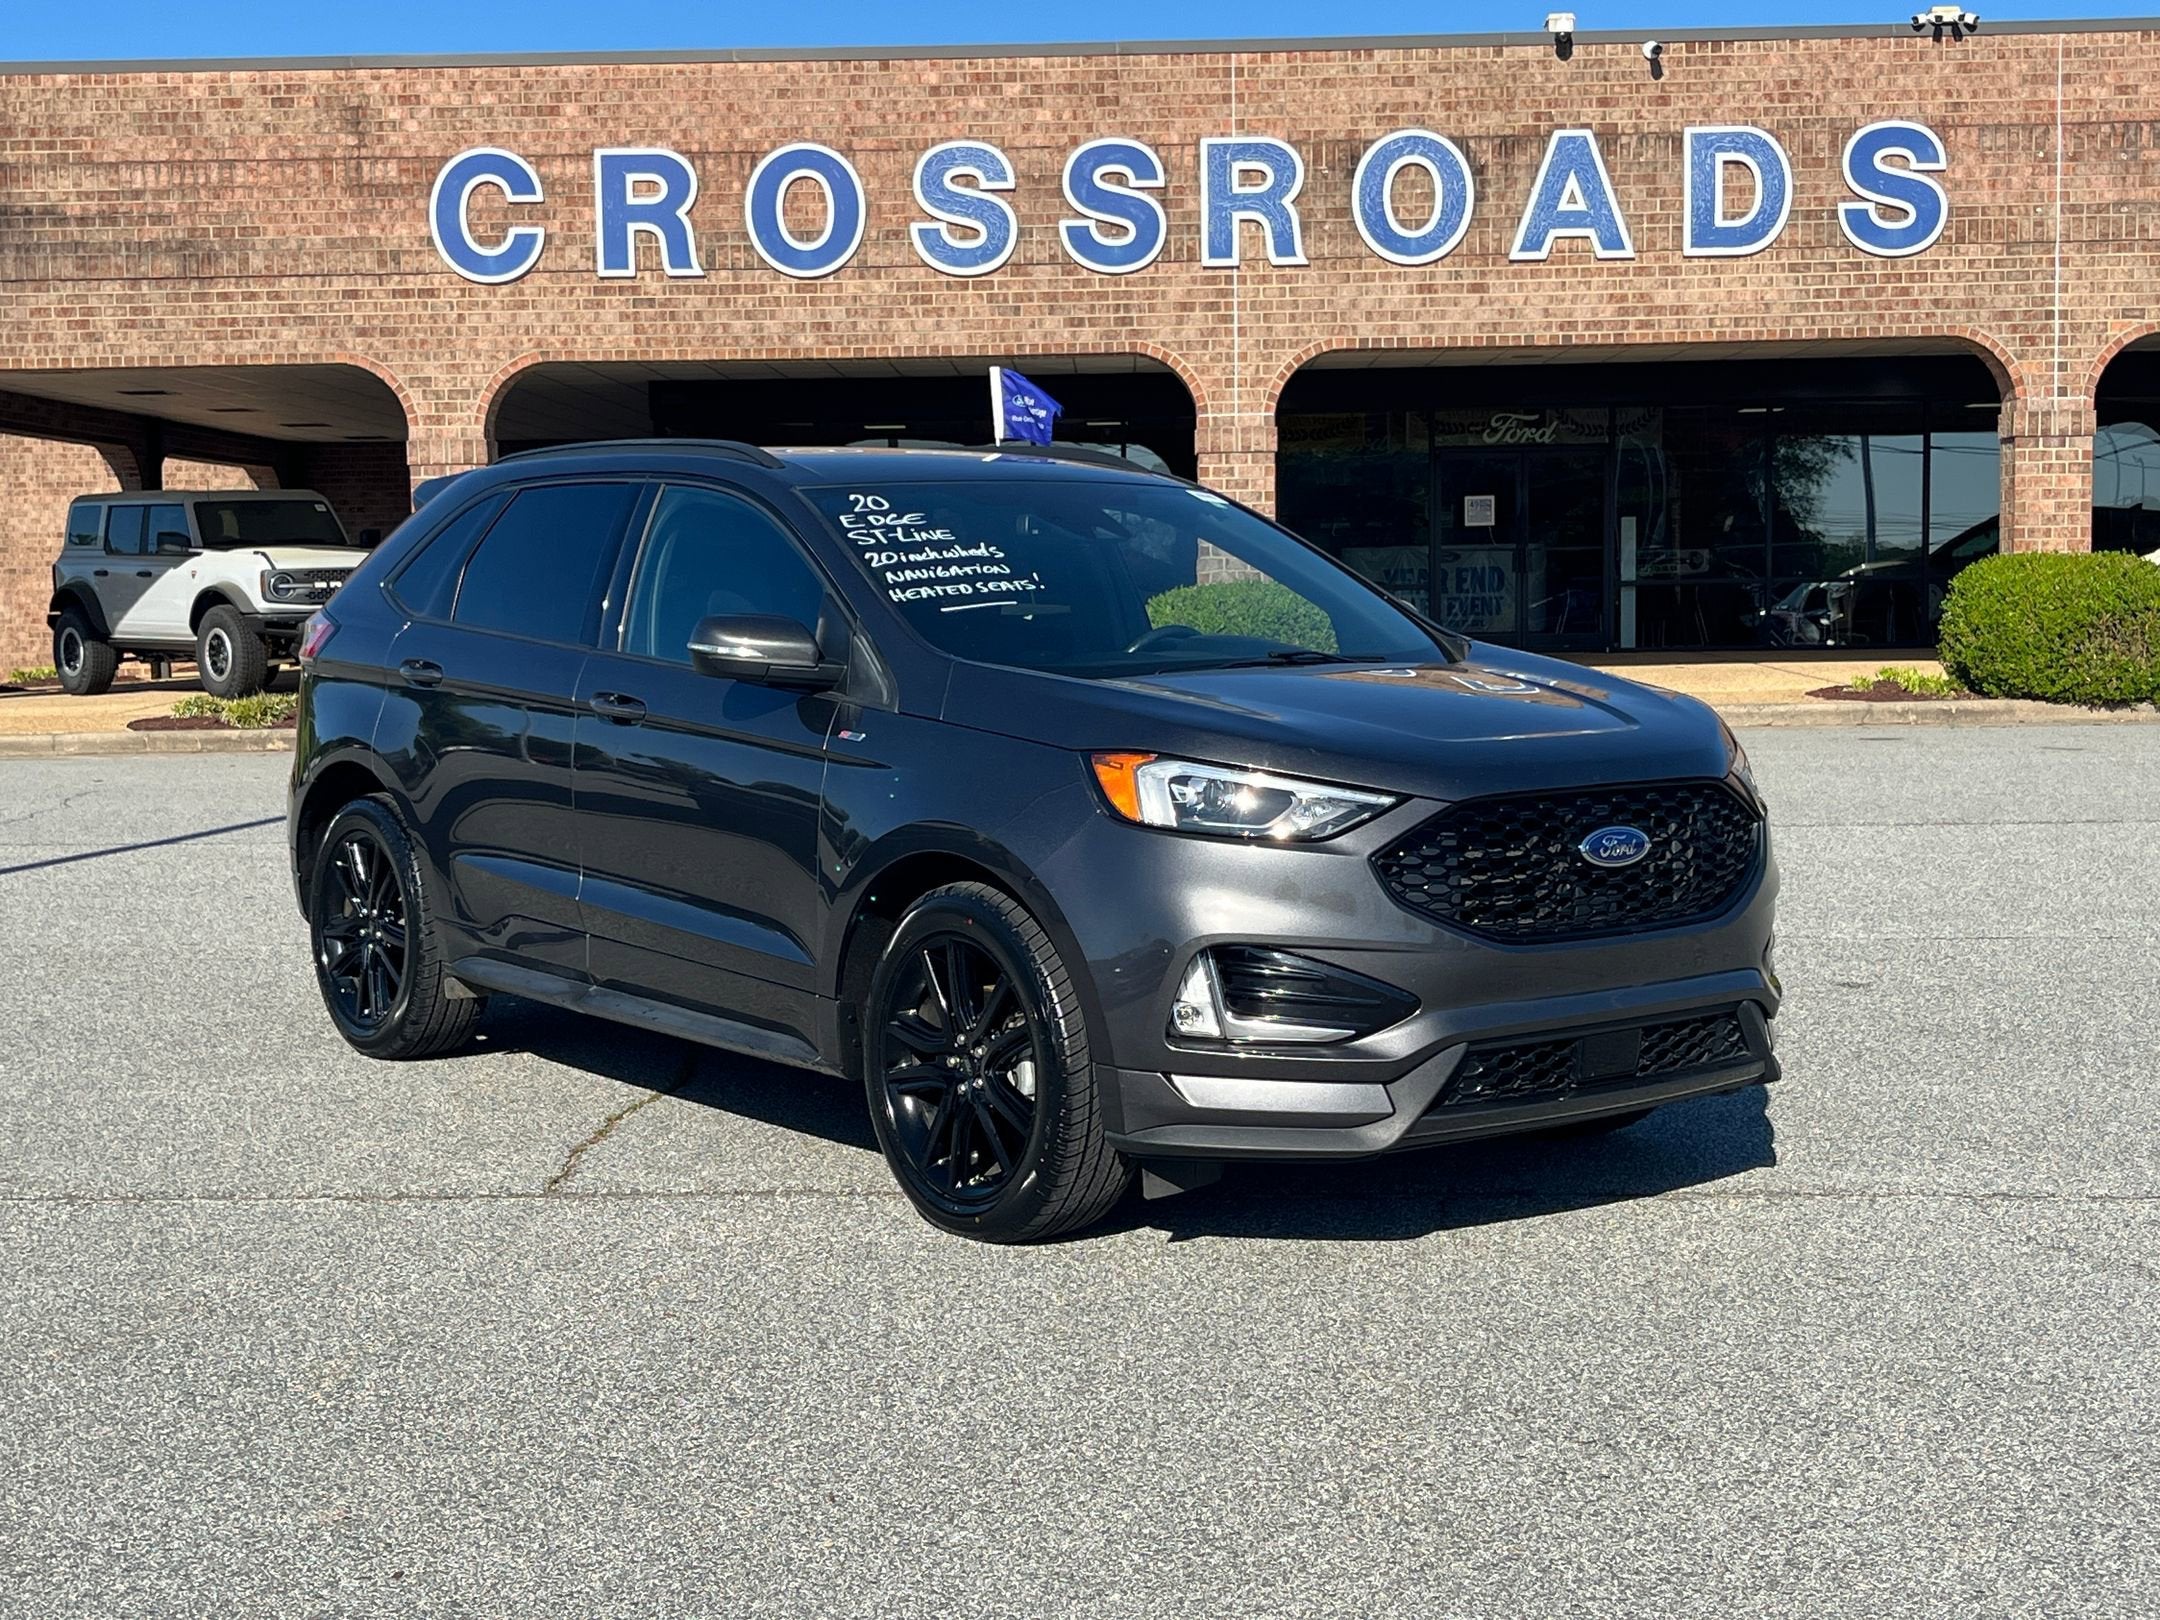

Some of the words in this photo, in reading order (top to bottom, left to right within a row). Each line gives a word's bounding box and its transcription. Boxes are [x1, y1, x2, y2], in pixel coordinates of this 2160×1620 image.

[428, 118, 1950, 286] CROSSROADS
[1482, 413, 1559, 444] Ford
[849, 493, 890, 512] 20
[839, 513, 927, 528] EDGE
[1454, 566, 1505, 594] END
[888, 583, 973, 602] HEATED
[1446, 596, 1504, 618] EVENT
[1600, 835, 1637, 858] Ford
